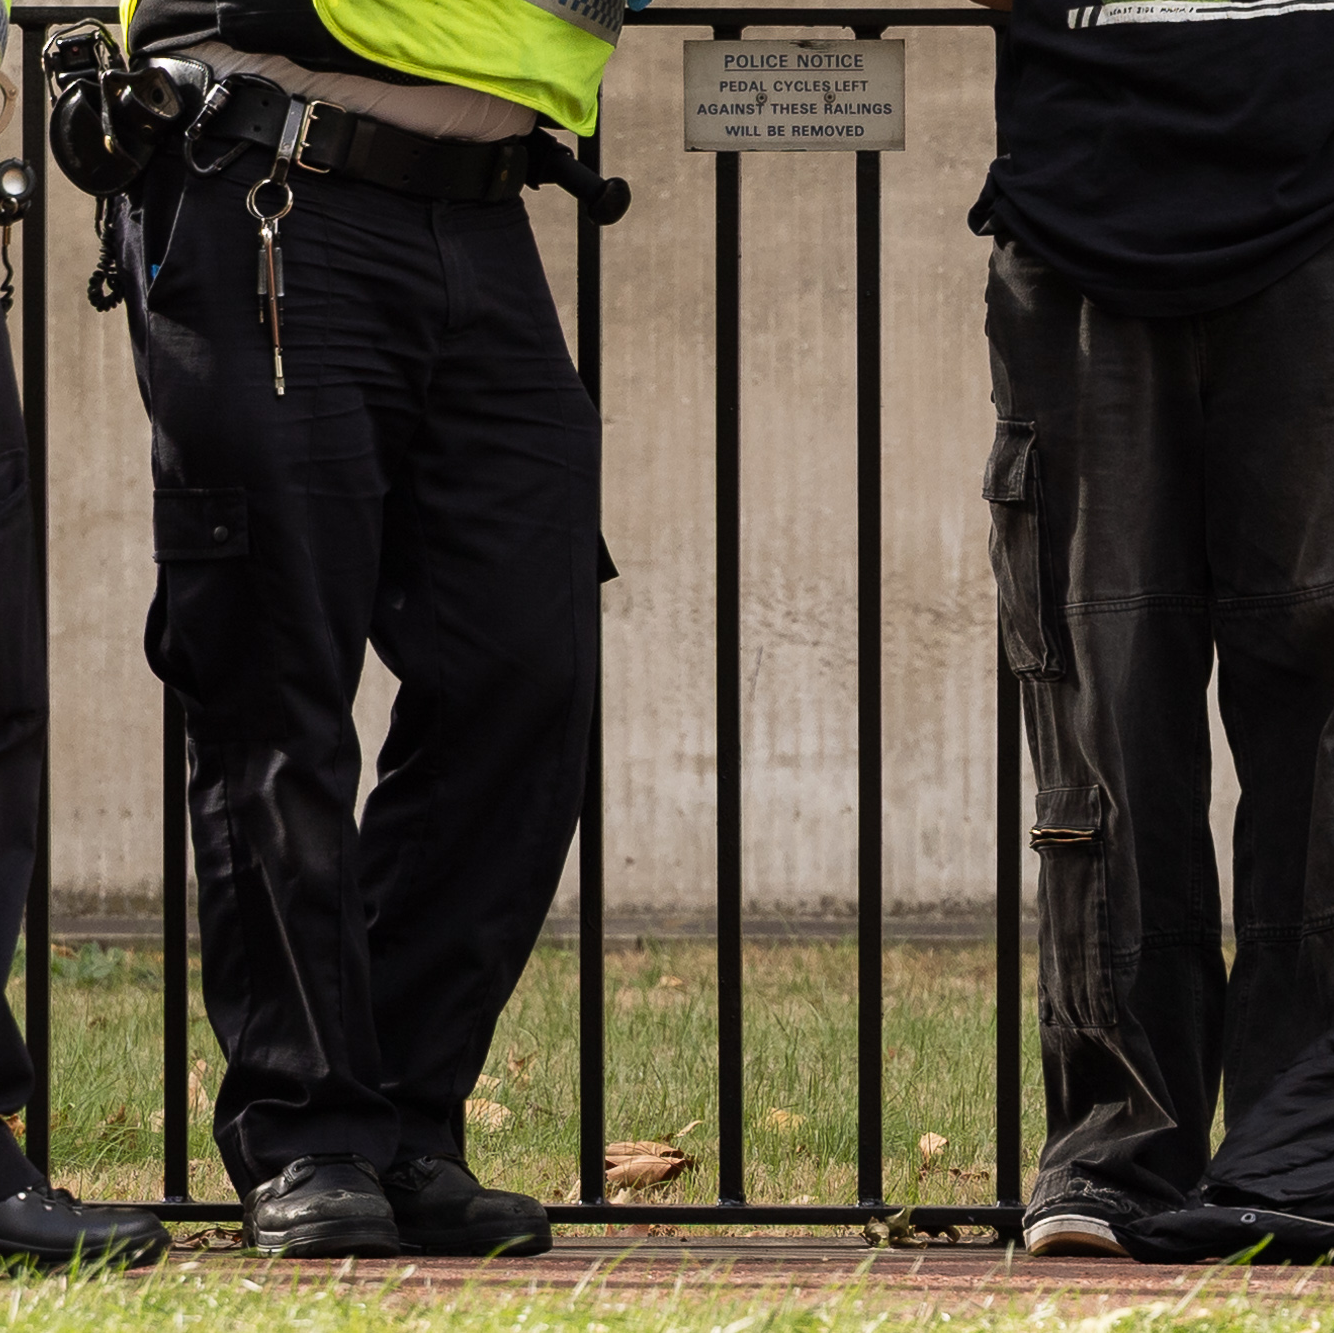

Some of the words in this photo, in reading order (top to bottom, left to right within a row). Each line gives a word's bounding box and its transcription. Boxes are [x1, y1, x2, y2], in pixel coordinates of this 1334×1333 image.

[724, 54, 789, 68] POLICE
[797, 54, 864, 68] NOTICE
[719, 80, 767, 93] PEDAL
[773, 80, 831, 93] CYCLES
[835, 80, 869, 92] LEFT
[697, 103, 765, 115] AGAINST
[770, 103, 818, 115] THESE
[824, 103, 893, 115] RAILINGS
[725, 125, 761, 137] WILL
[767, 125, 785, 137] BE
[791, 125, 865, 137] REMOVED
